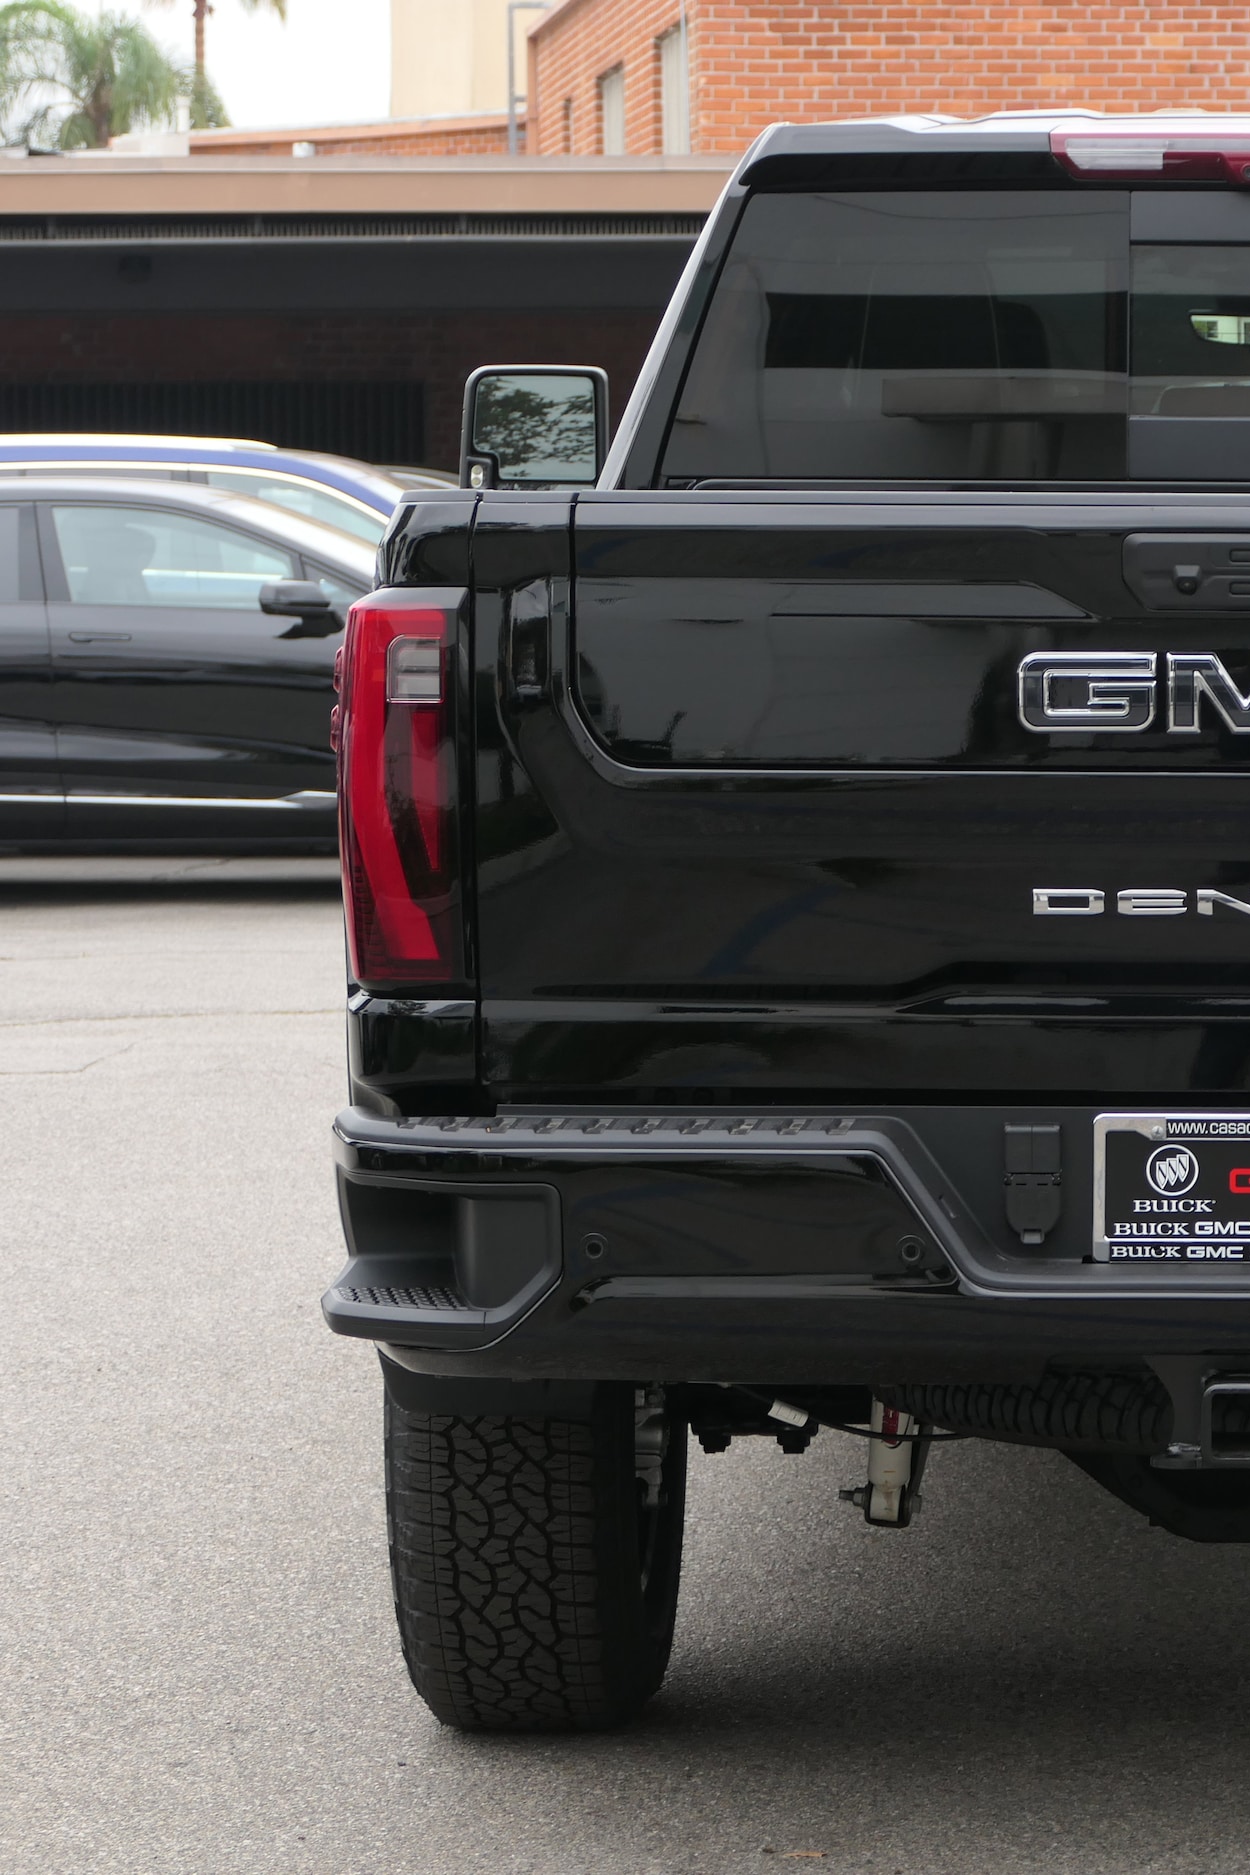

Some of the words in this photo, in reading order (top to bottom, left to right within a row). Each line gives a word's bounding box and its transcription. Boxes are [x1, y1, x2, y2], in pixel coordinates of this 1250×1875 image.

[1133, 1200, 1213, 1213] BUICK
[1114, 1223, 1190, 1236] BUICK
[1111, 1246, 1181, 1258] BUICK
[1186, 1246, 1244, 1259] GMC
